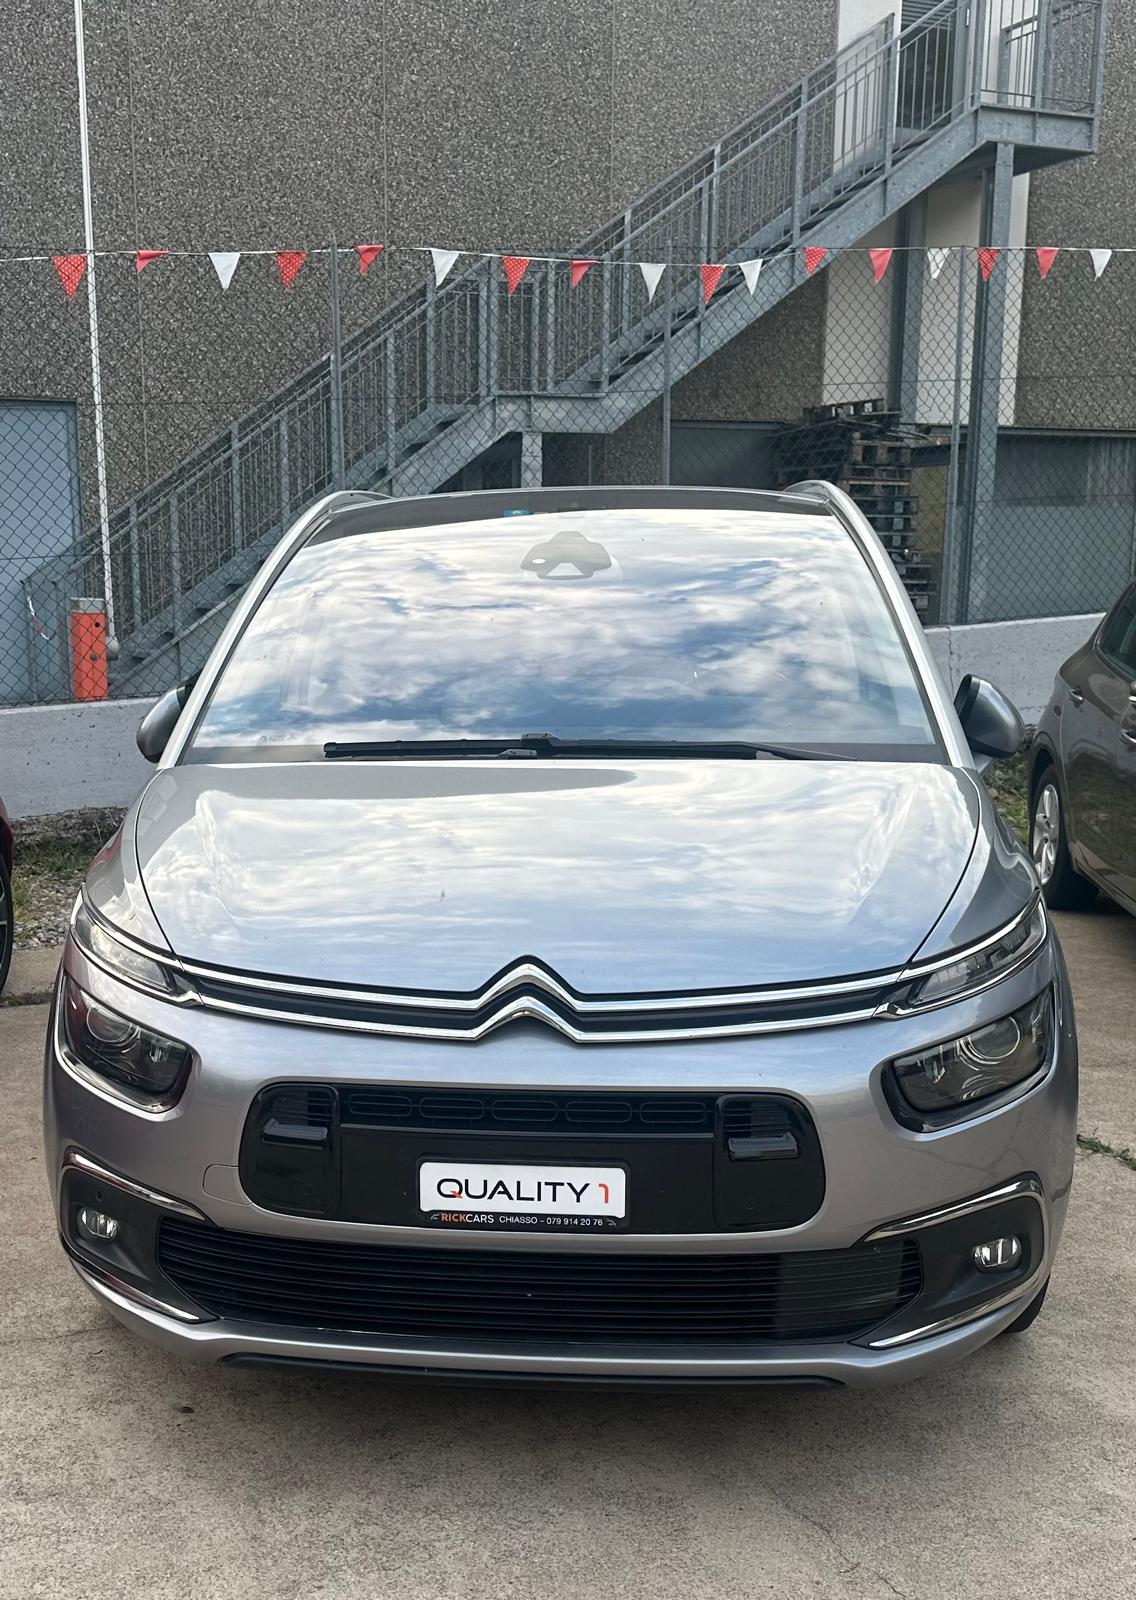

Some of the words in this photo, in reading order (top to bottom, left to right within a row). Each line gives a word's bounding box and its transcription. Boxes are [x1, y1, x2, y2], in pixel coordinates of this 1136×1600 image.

[441, 1213, 495, 1224] RICKCARS
[499, 1215, 538, 1224] CHIASSO
[546, 1217, 561, 1225] 079
[563, 1217, 578, 1225] 914
[580, 1218, 591, 1226] 20
[593, 1218, 603, 1226] 76
